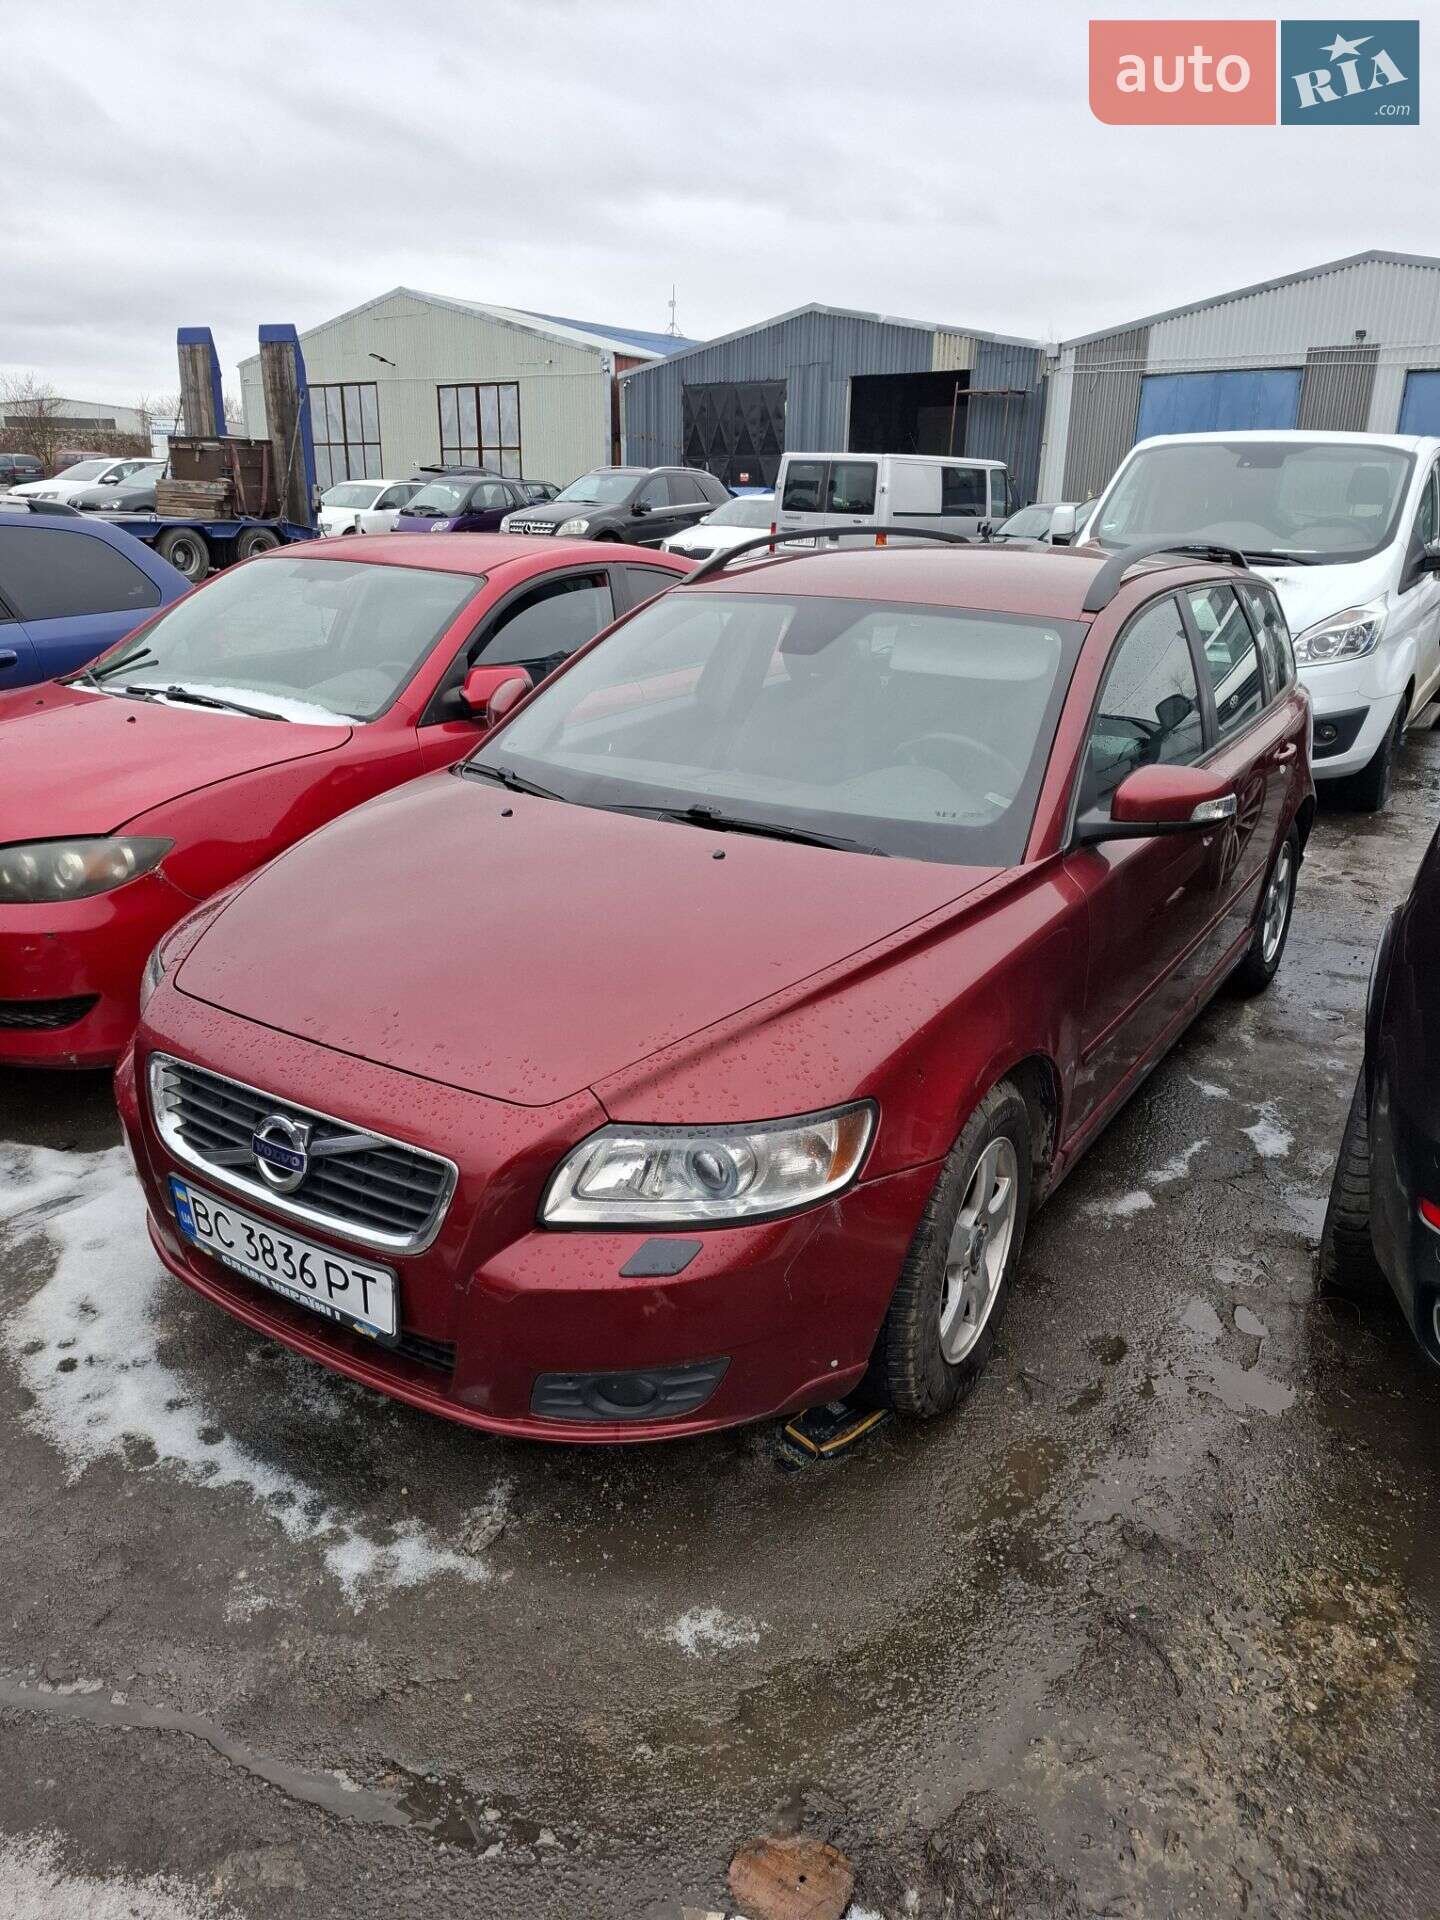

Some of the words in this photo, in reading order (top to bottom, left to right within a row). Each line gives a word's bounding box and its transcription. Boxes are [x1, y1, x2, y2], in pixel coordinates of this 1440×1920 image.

[254, 1142, 301, 1167] VOLVO
[191, 1196, 235, 1248] BC
[240, 1223, 317, 1290] 3836
[324, 1260, 377, 1315] PT
